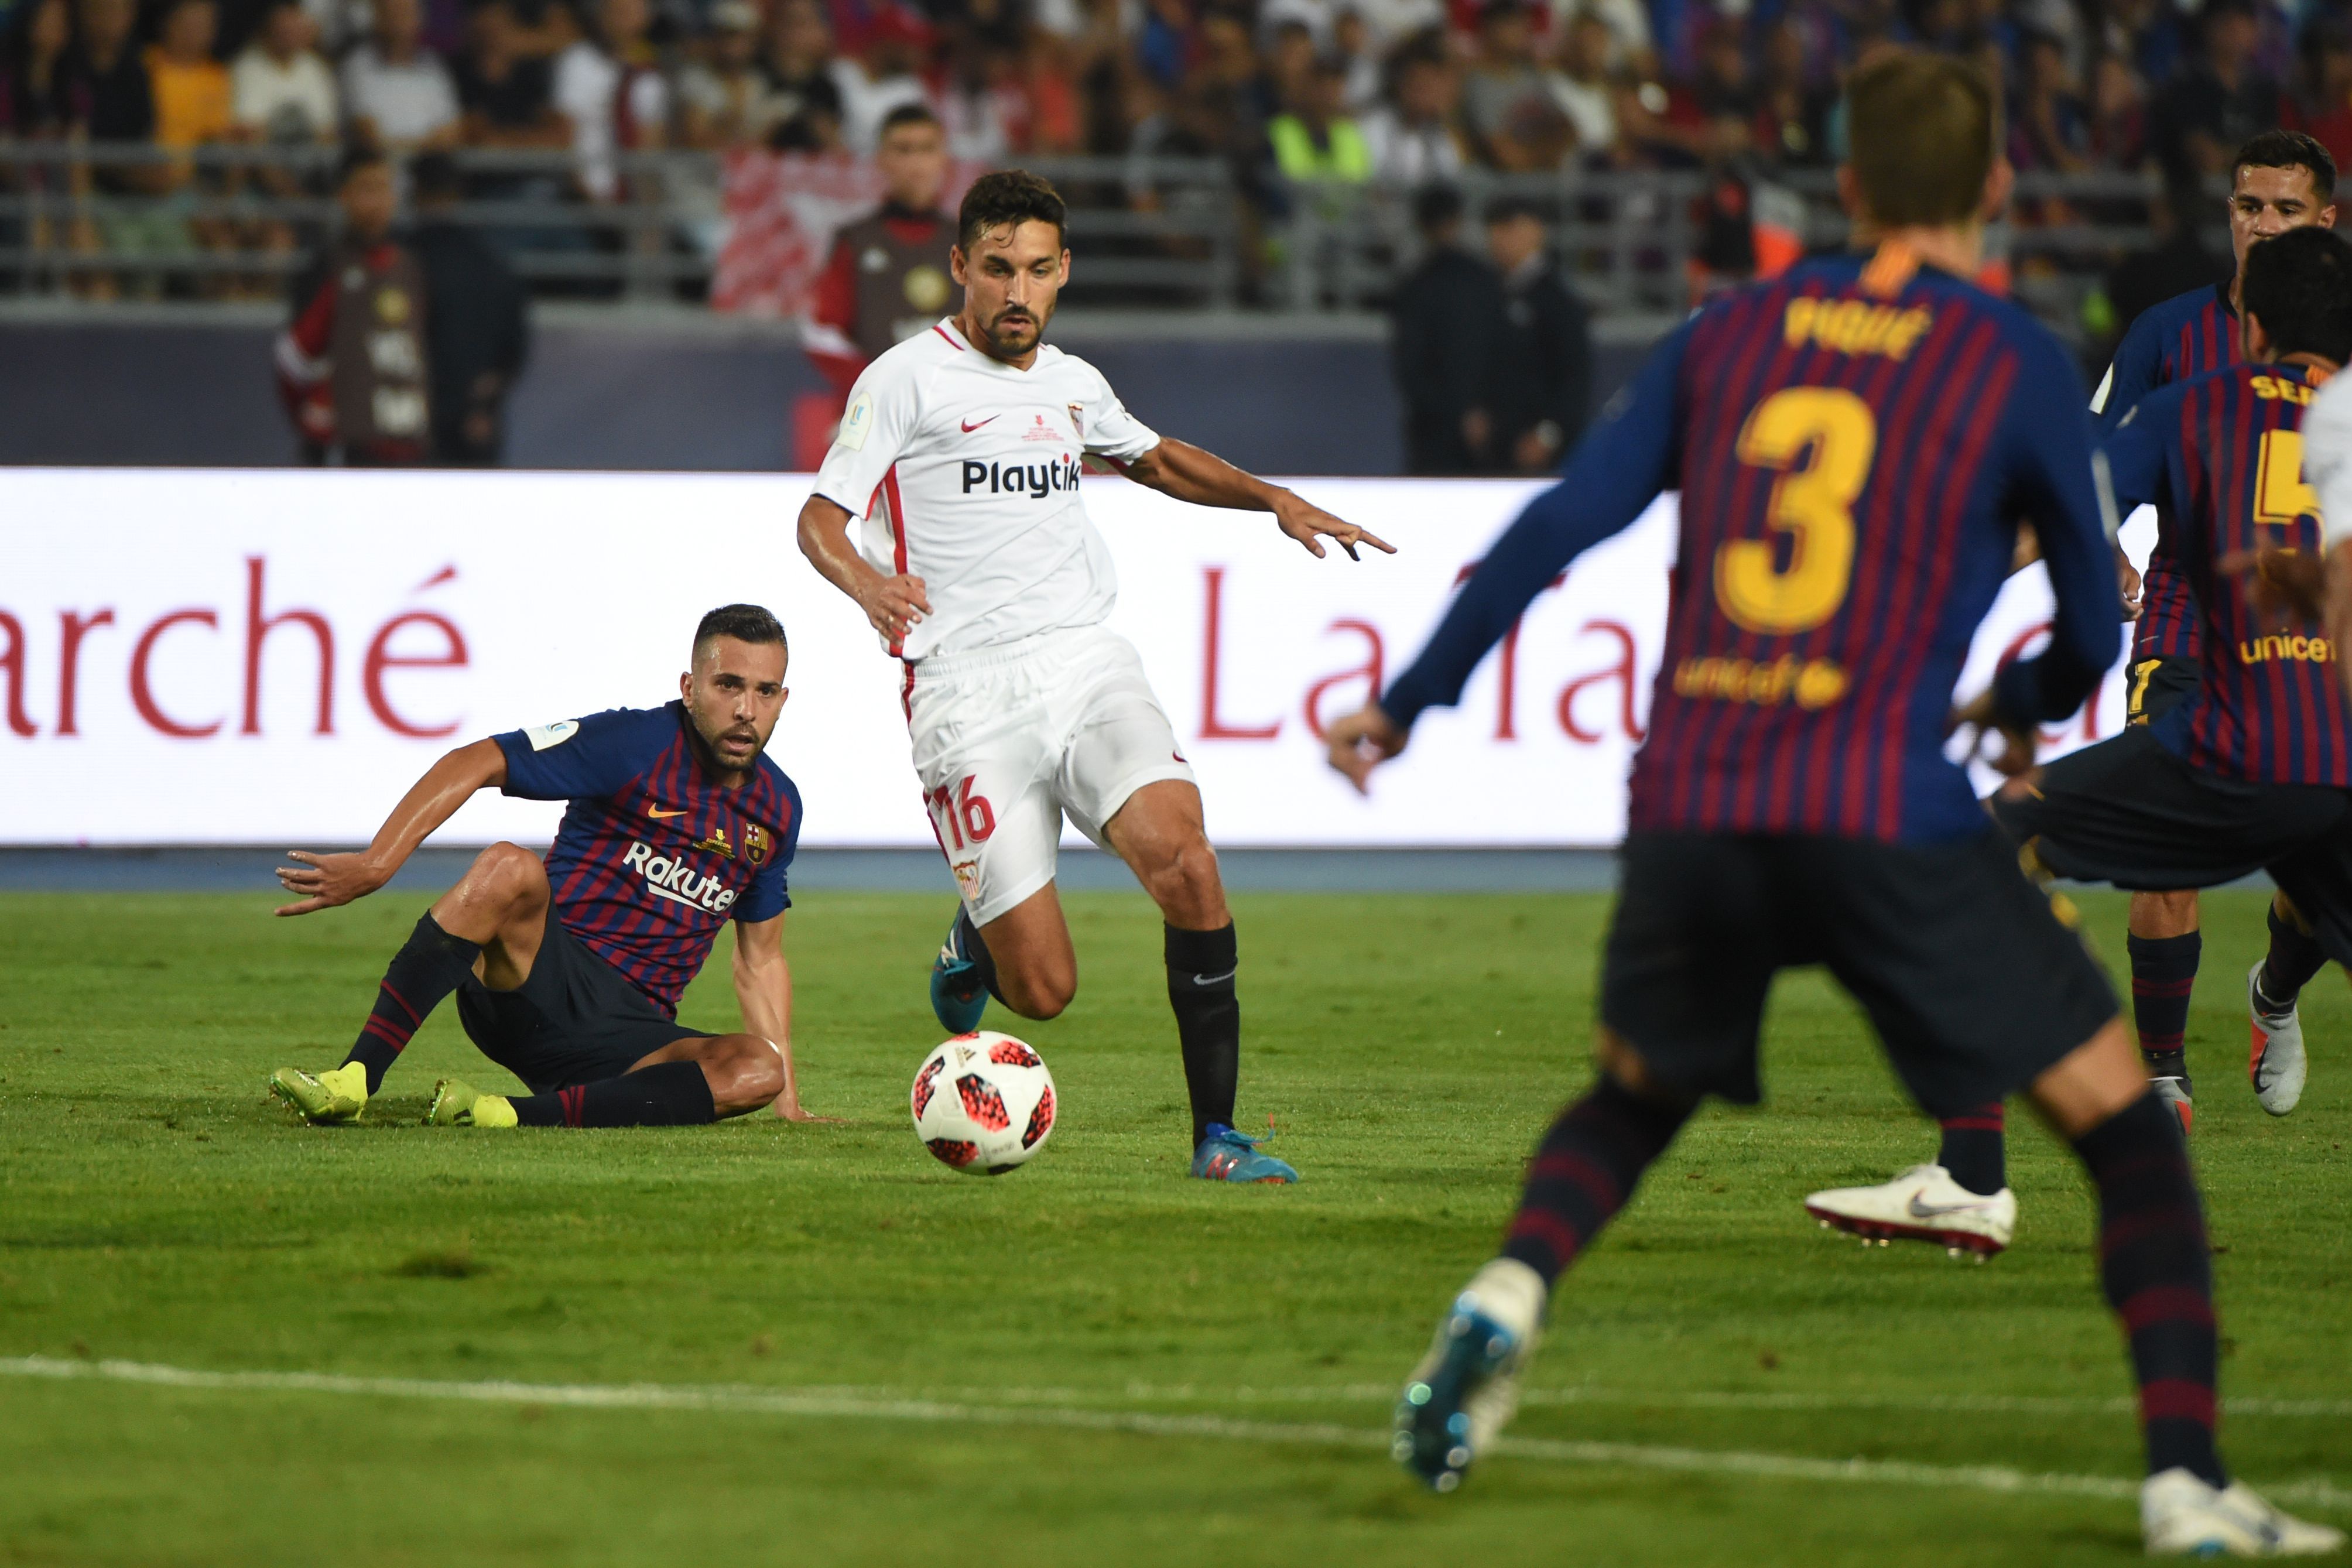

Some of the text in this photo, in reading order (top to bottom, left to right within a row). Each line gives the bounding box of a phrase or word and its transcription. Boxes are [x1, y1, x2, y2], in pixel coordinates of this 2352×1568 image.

[963, 453, 1080, 499] Playtik
[1714, 385, 1876, 636] 3
[931, 774, 996, 851] 16
[622, 840, 740, 912] Rakute
